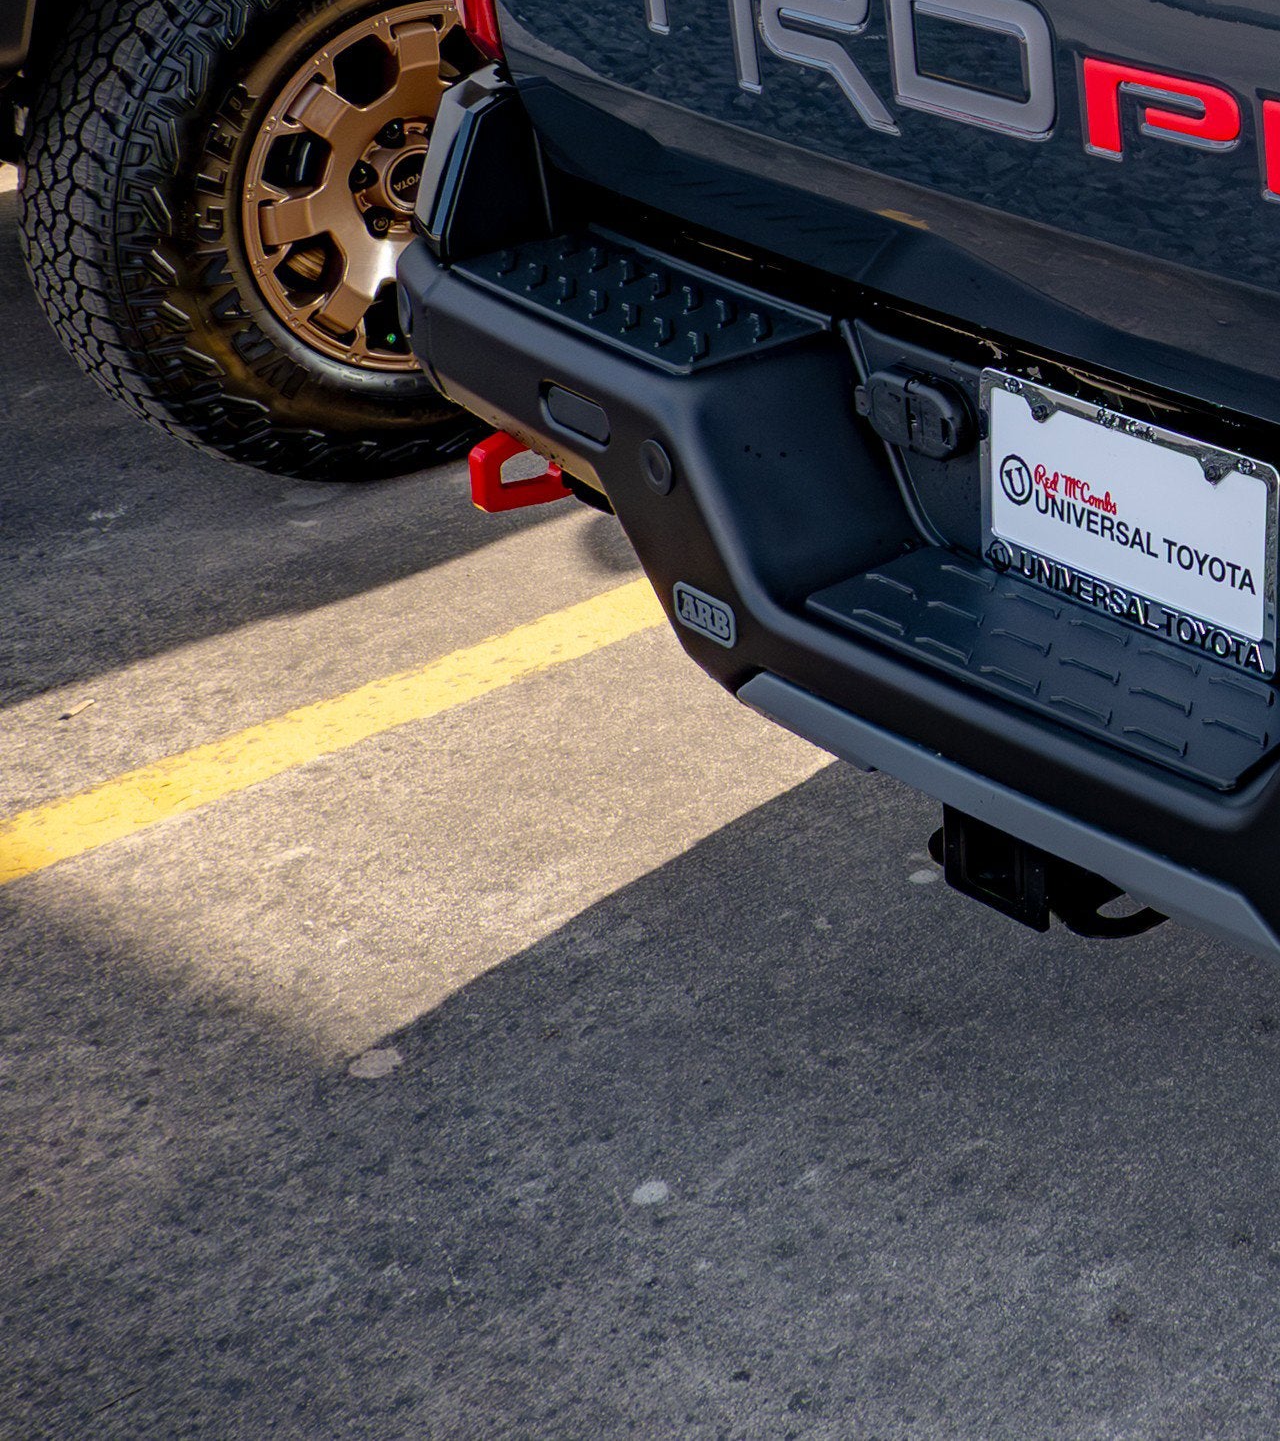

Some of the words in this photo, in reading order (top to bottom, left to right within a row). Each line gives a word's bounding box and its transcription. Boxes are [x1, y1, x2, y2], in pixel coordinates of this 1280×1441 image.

[393, 173, 421, 192] YOTA
[1034, 463, 1059, 496] Red
[1062, 473, 1118, 516] McCombs
[1035, 488, 1159, 558] UNIVERSAL
[1163, 537, 1257, 596] TOYOTA
[680, 590, 731, 639] ARB
[1019, 550, 1160, 631] UNIVERSAL
[1161, 607, 1267, 675] TOYOTA
